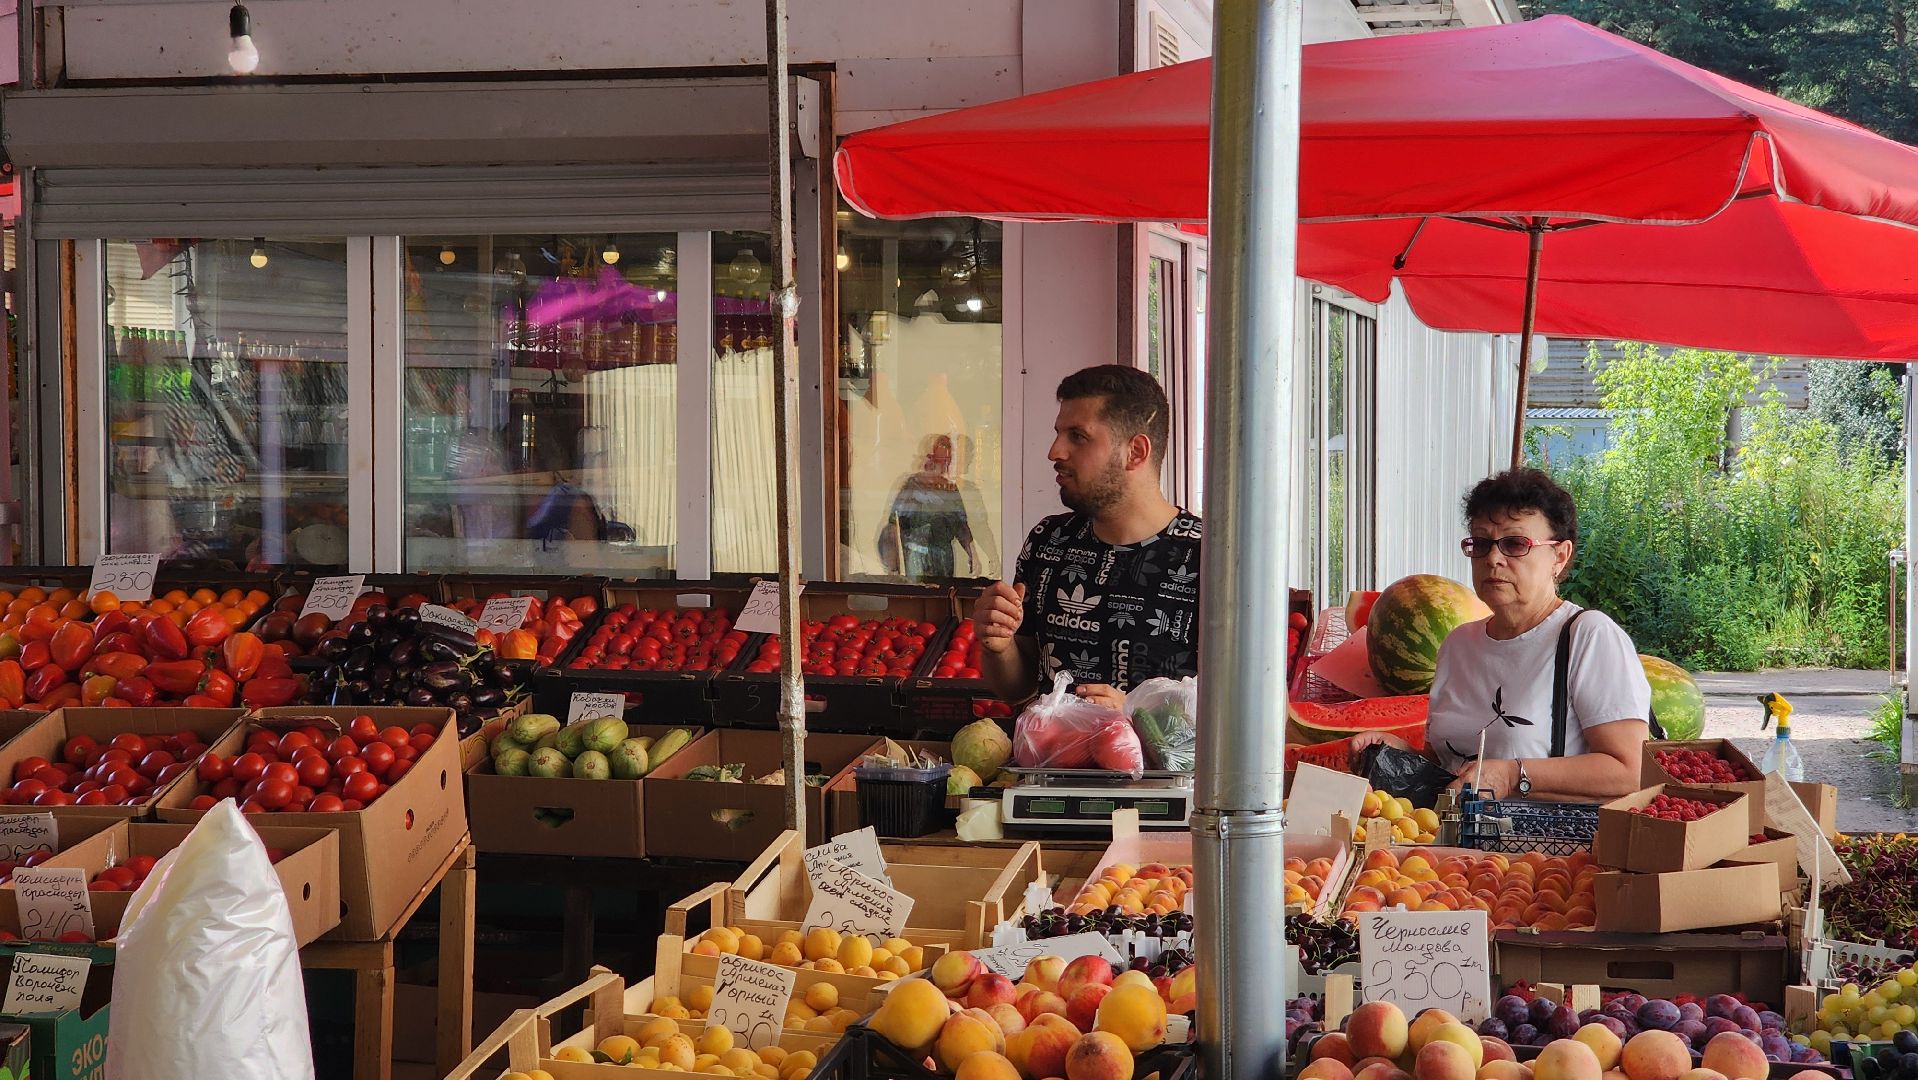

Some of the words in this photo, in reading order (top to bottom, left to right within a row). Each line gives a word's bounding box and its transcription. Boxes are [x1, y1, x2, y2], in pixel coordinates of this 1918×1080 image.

[1160, 582, 1197, 594] adidas
[1107, 601, 1144, 612] adidas
[1047, 613, 1101, 633] adidas
[1170, 609, 1184, 642] adidas
[1069, 668, 1103, 681] didas
[834, 879, 893, 917] Армения
[23, 908, 86, 940] 240
[1372, 916, 1471, 941] Чернослив
[12, 955, 80, 984] Помидор
[1364, 959, 1464, 1002] 250
